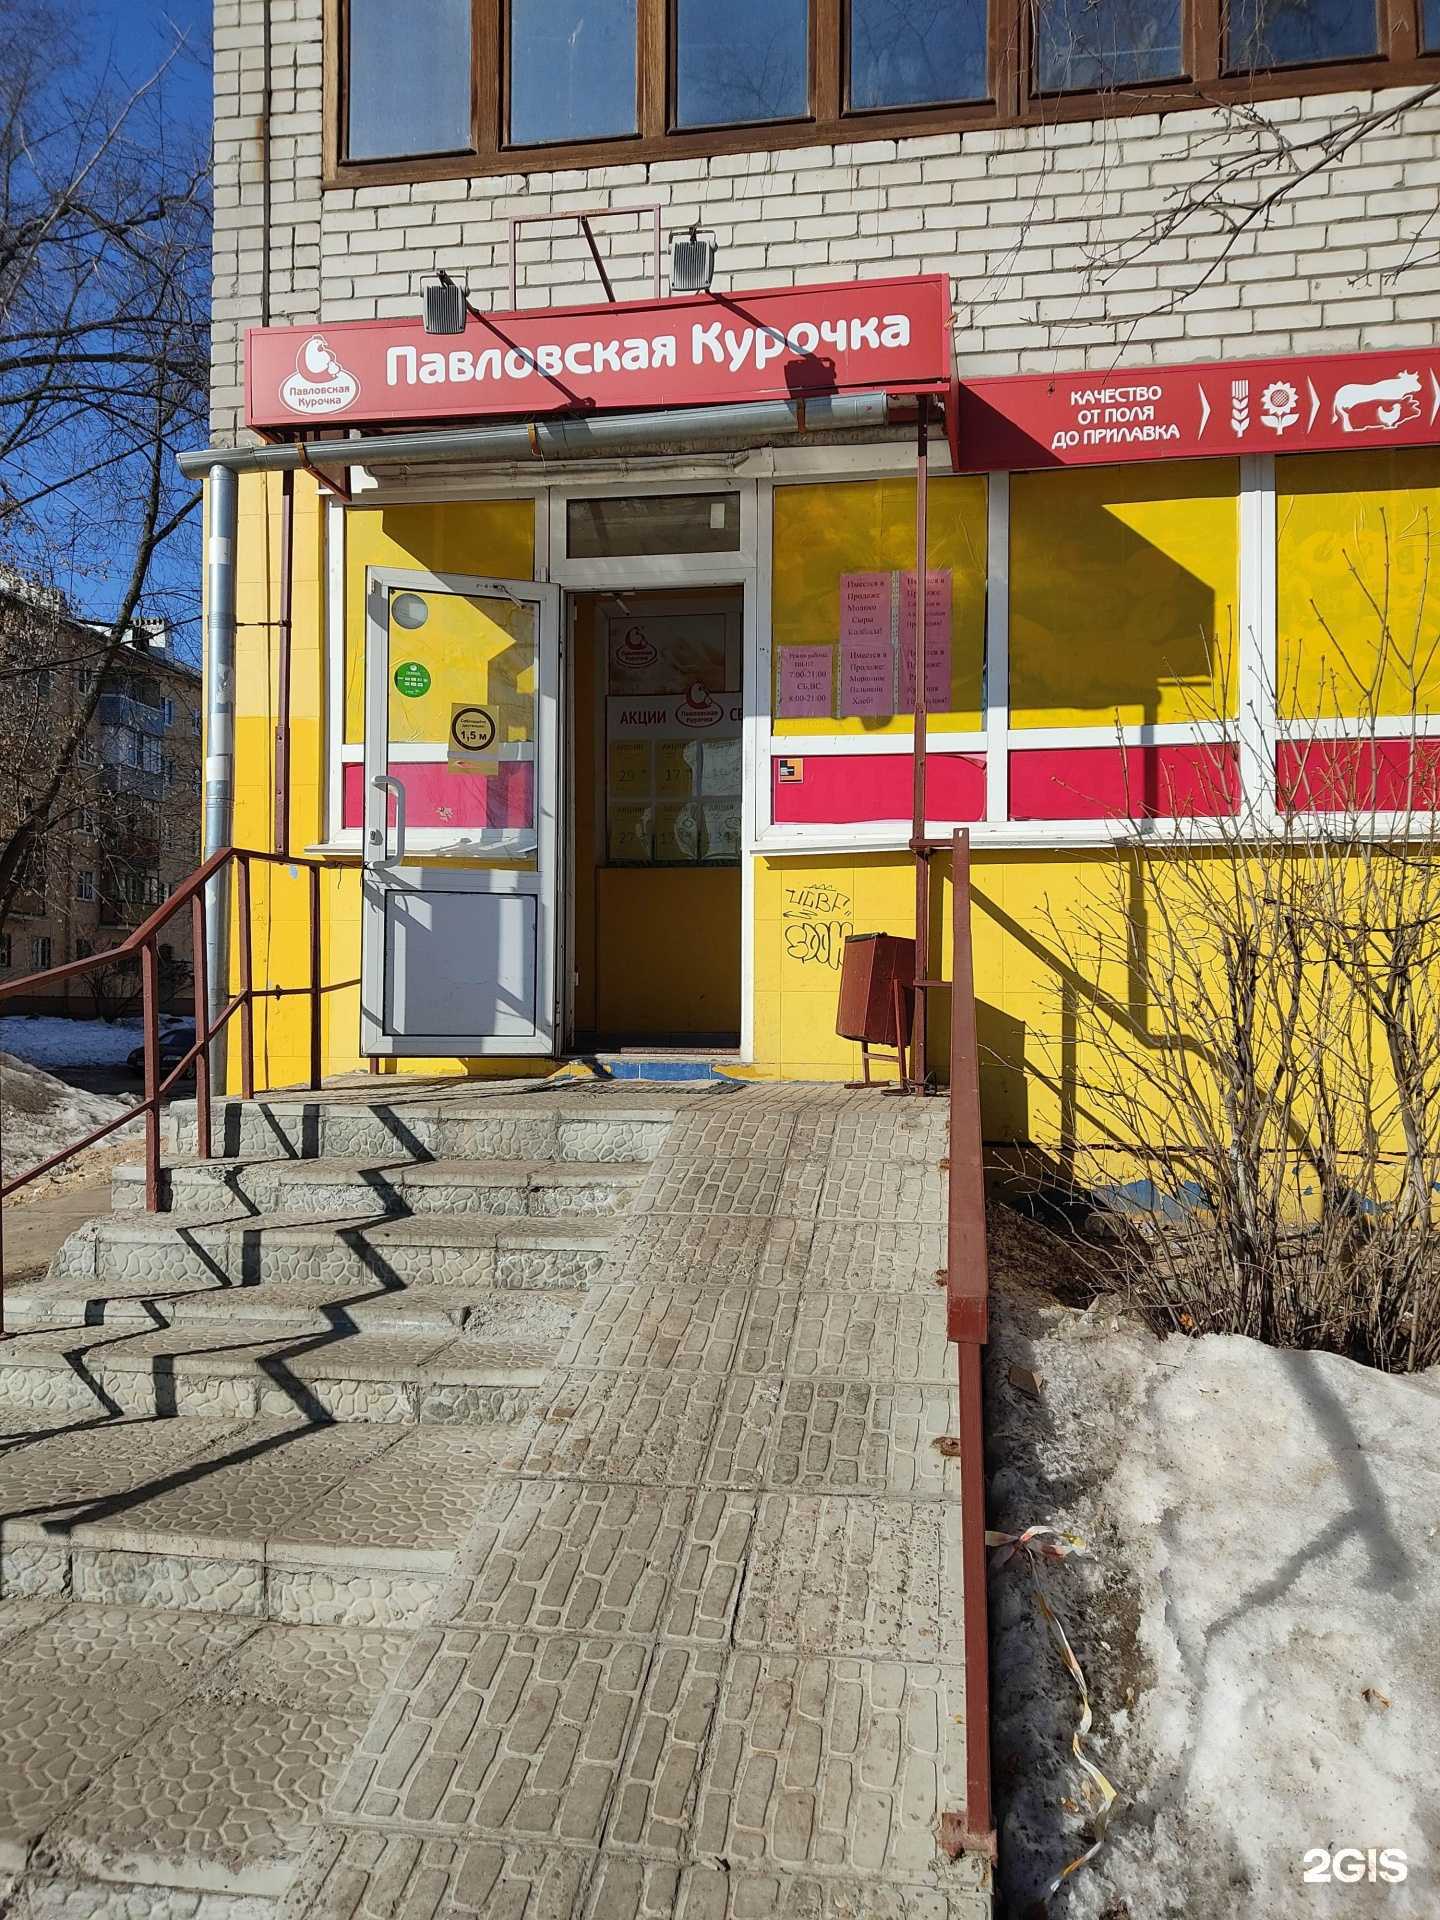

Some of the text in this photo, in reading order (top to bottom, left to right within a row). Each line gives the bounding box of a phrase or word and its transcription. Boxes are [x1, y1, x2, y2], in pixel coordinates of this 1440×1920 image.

[386, 314, 911, 386] Павловская Курочка
[289, 385, 350, 396] Павловская
[1070, 385, 1162, 405] КАЧЕСТВО
[298, 397, 342, 409] Курочка
[1077, 405, 1155, 425] ОТ ПОЛЯ
[1051, 424, 1180, 449] ДО ПРИЛАВКА
[620, 709, 666, 726] АКЦИИ
[461, 731, 476, 742] 1,5
